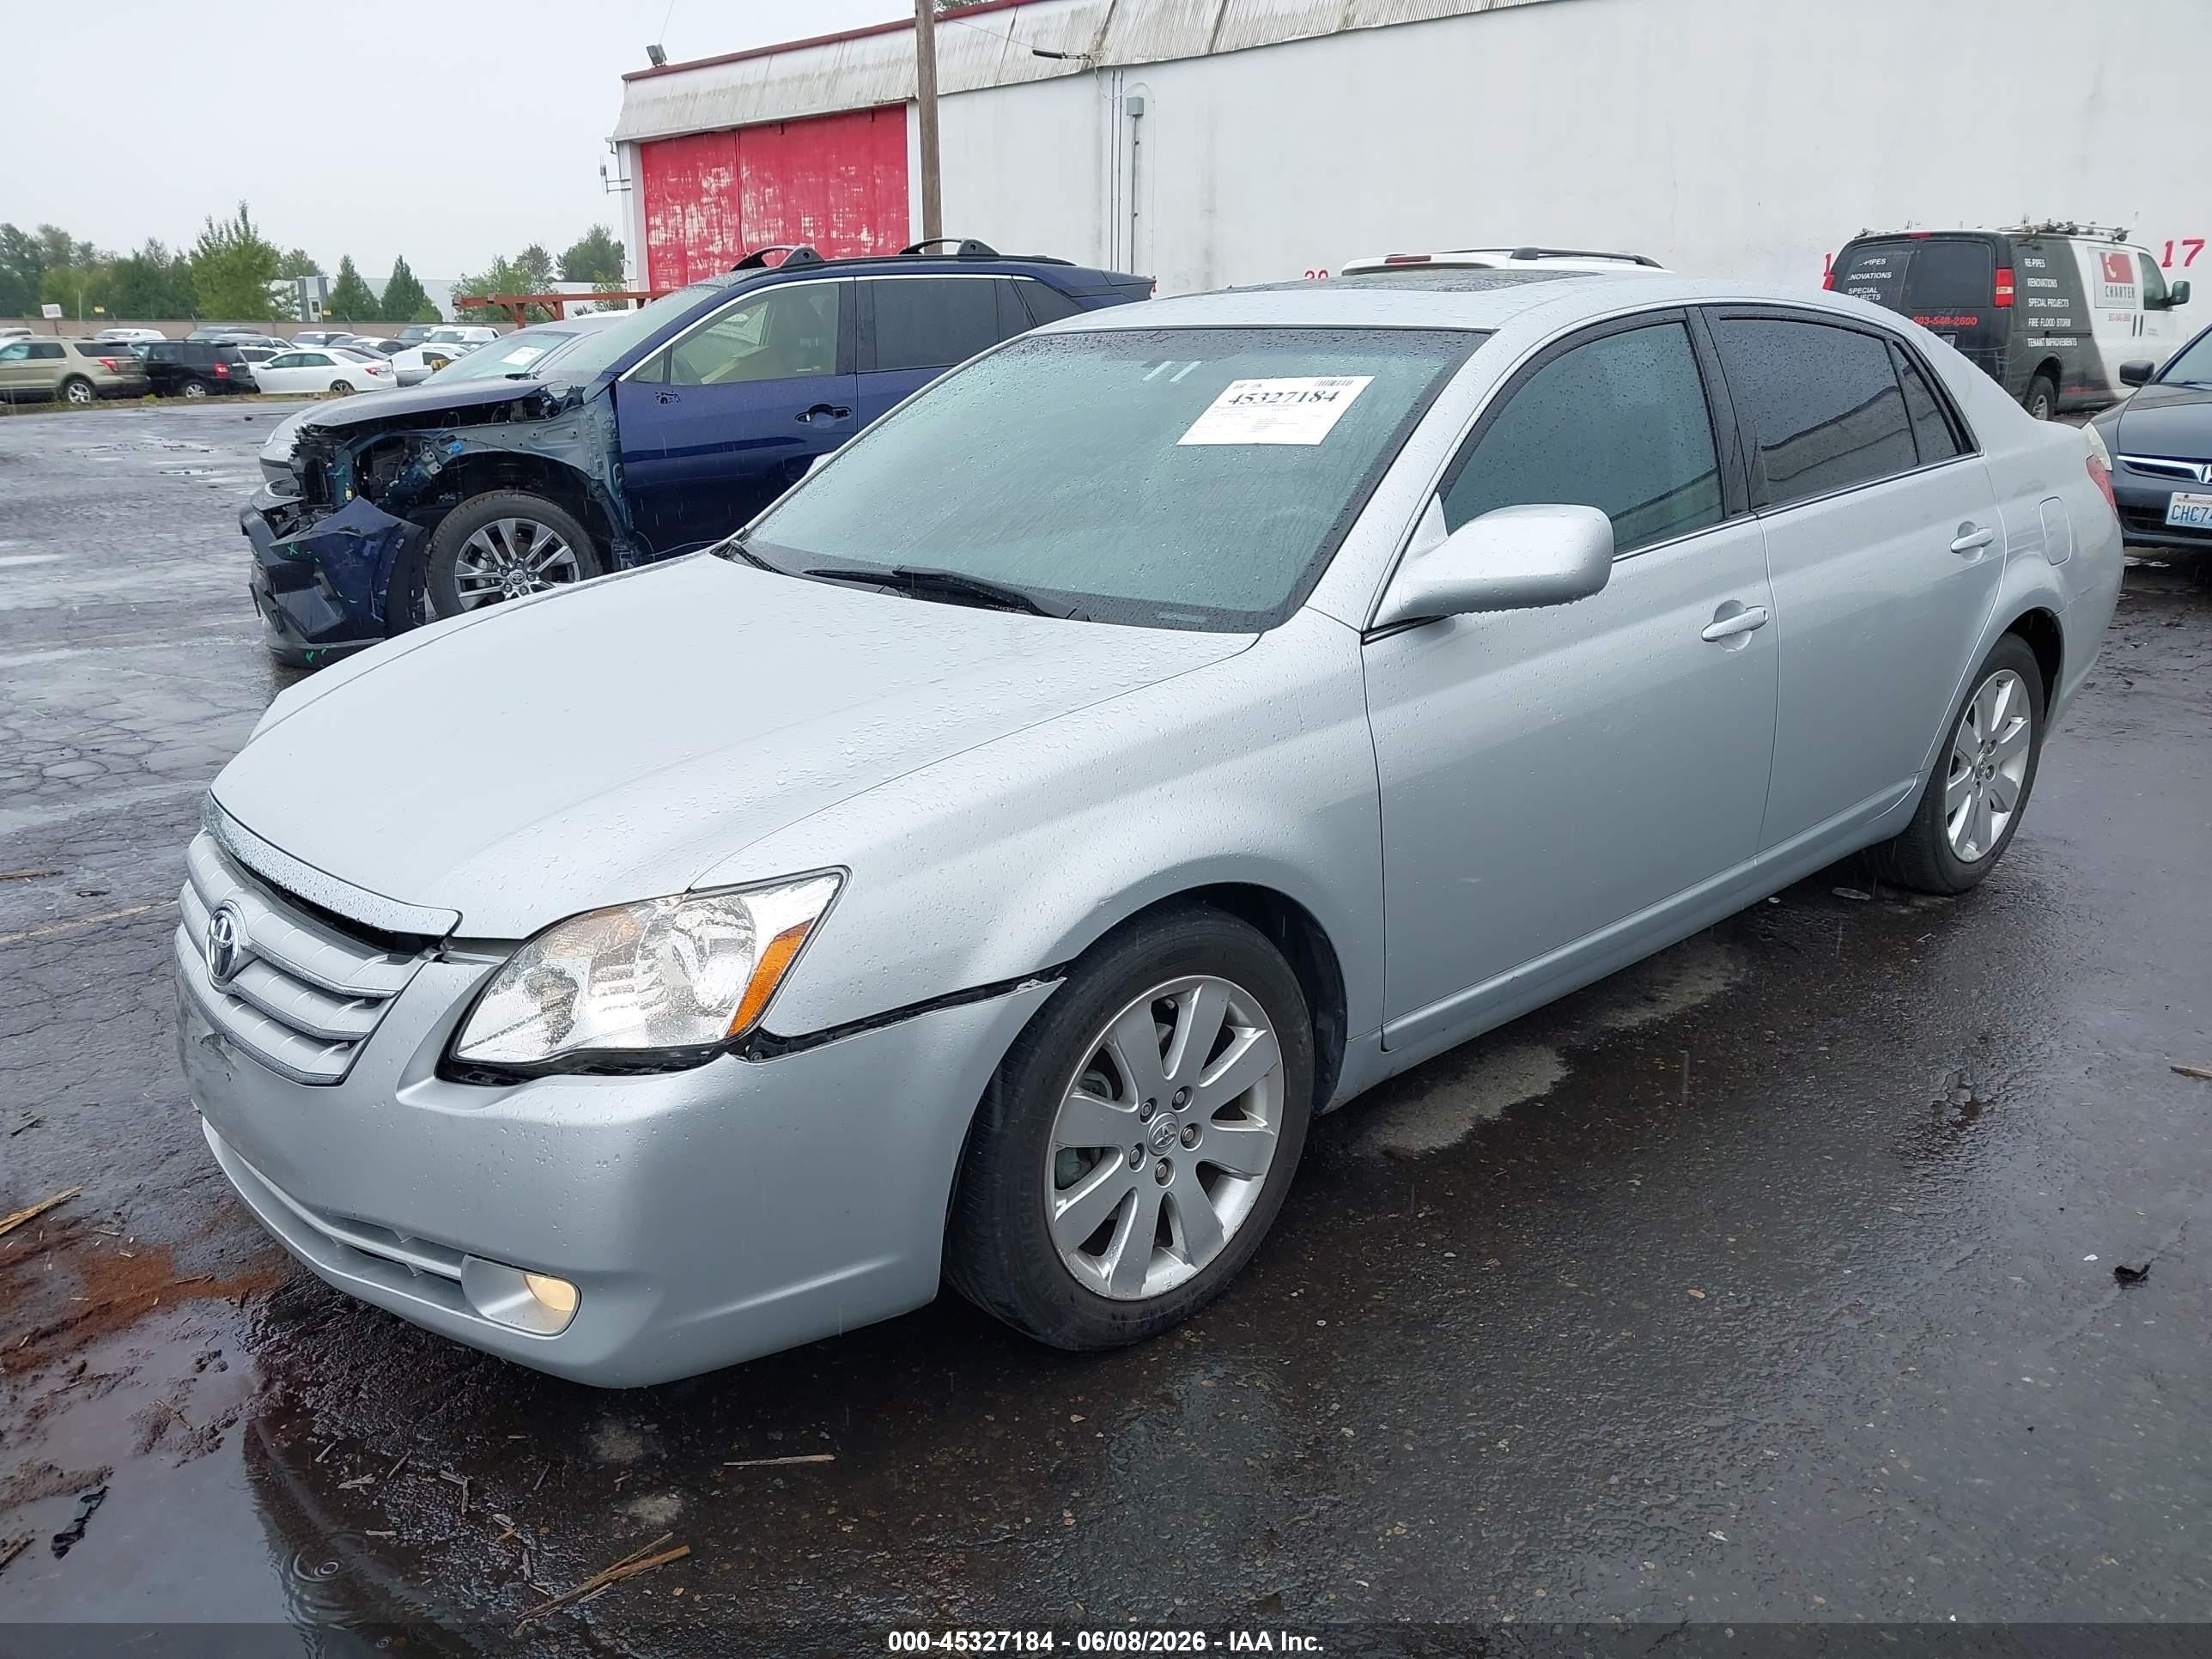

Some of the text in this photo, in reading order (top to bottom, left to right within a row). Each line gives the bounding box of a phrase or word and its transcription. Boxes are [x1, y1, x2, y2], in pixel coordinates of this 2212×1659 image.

[2161, 240, 2205, 267] 17
[1847, 271, 1892, 281] NOVATIONS
[2027, 277, 2058, 289] RENOVATIONS
[2105, 284, 2136, 299] CHARTER
[2028, 297, 2069, 308] SPECIAL PROJECTS
[2028, 318, 2072, 327] FIRE FLOOD STORM
[2027, 337, 2078, 347] TENANT IMPROVEMENTS
[1228, 390, 1340, 405] 45327184
